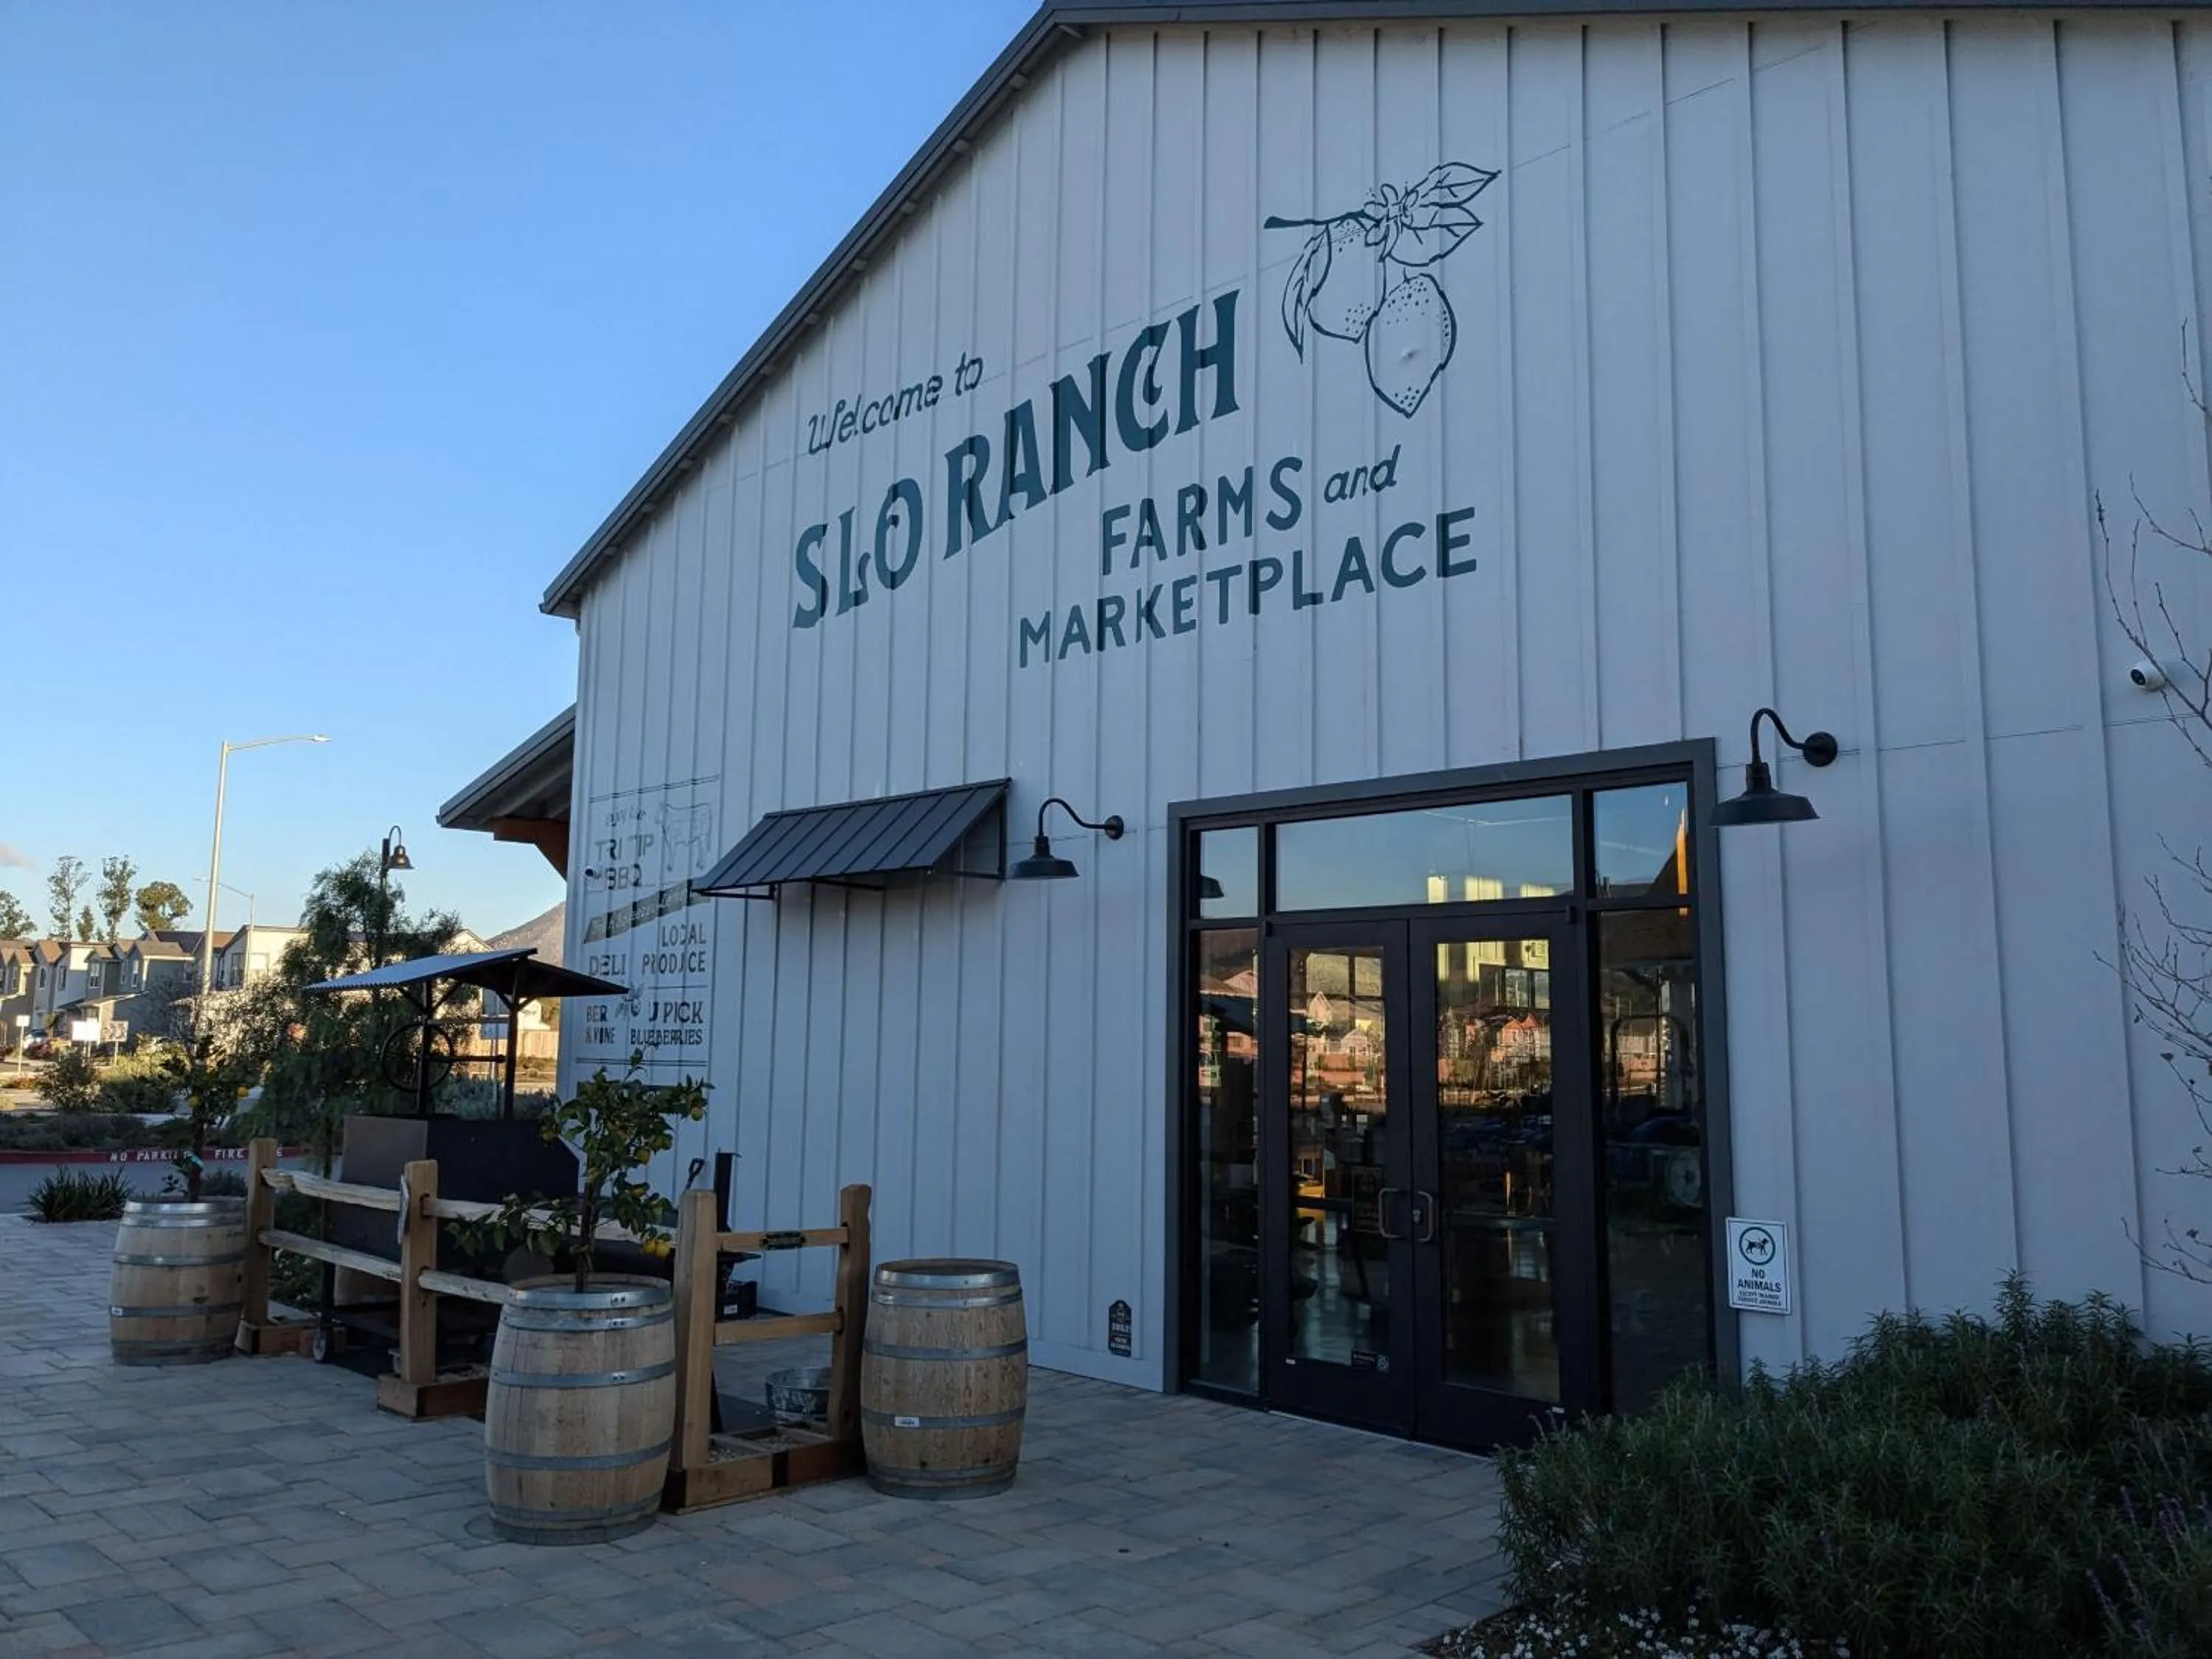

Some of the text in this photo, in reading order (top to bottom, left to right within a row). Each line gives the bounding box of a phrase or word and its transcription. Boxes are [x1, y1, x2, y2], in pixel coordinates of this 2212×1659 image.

[808, 351, 984, 455] Welcome to
[792, 288, 1240, 629] SLO RANCH
[1102, 445, 1401, 576] FARMS and
[1019, 507, 1478, 668] MARKETPLACE
[605, 863, 641, 891] BBQ
[661, 922, 707, 948] LOCAL
[589, 954, 626, 977] DELI
[641, 951, 706, 975] PRODUCE
[663, 1001, 704, 1024] PICK
[630, 1028, 703, 1046] BLUEBERRIES
[110, 1152, 128, 1162] NO
[215, 1148, 245, 1159] FIRE
[1751, 1267, 1765, 1279] NO
[1737, 1278, 1782, 1293] ANIMALS
